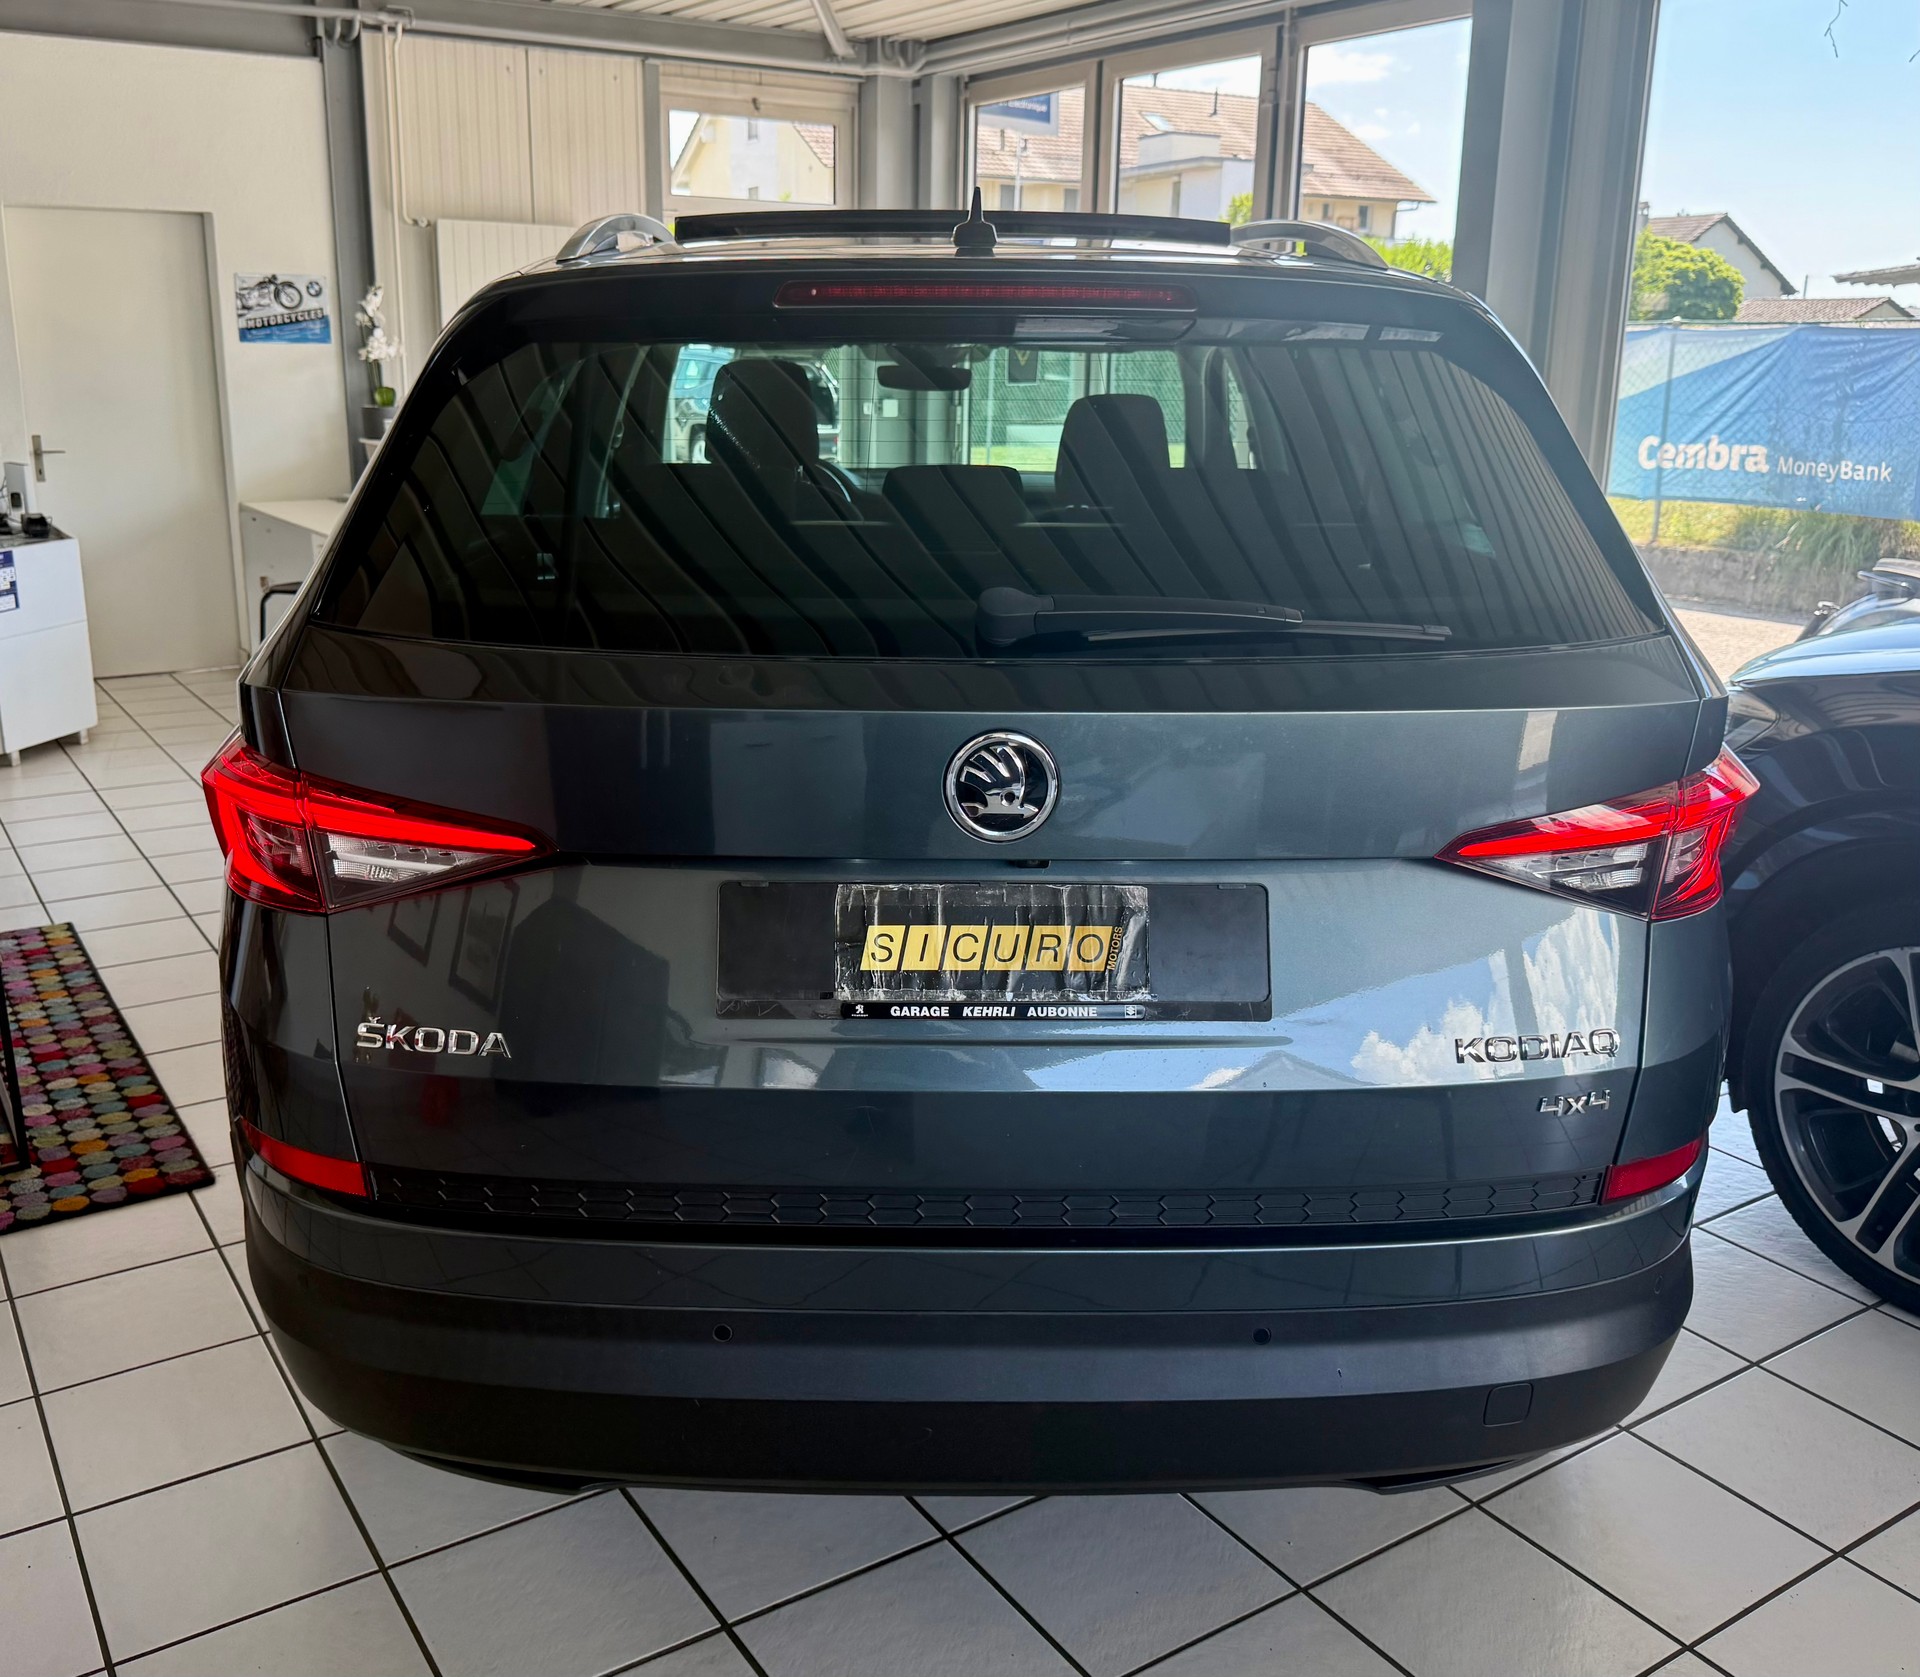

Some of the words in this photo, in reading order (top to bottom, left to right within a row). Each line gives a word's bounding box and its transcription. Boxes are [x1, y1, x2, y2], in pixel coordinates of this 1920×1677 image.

[247, 309, 324, 329] MOTORCYCLES
[1638, 434, 1770, 474] Cembra
[1777, 456, 1893, 483] MoneyBank
[869, 932, 1106, 965] SICURO
[1106, 926, 1123, 971] MOTORS
[890, 1006, 950, 1017] GARAGE
[962, 1006, 1016, 1017] KEHRLI
[1027, 1006, 1098, 1017] AUBONNE
[356, 1016, 512, 1059] ŠKODA
[1454, 1028, 1621, 1064] KODIAQ
